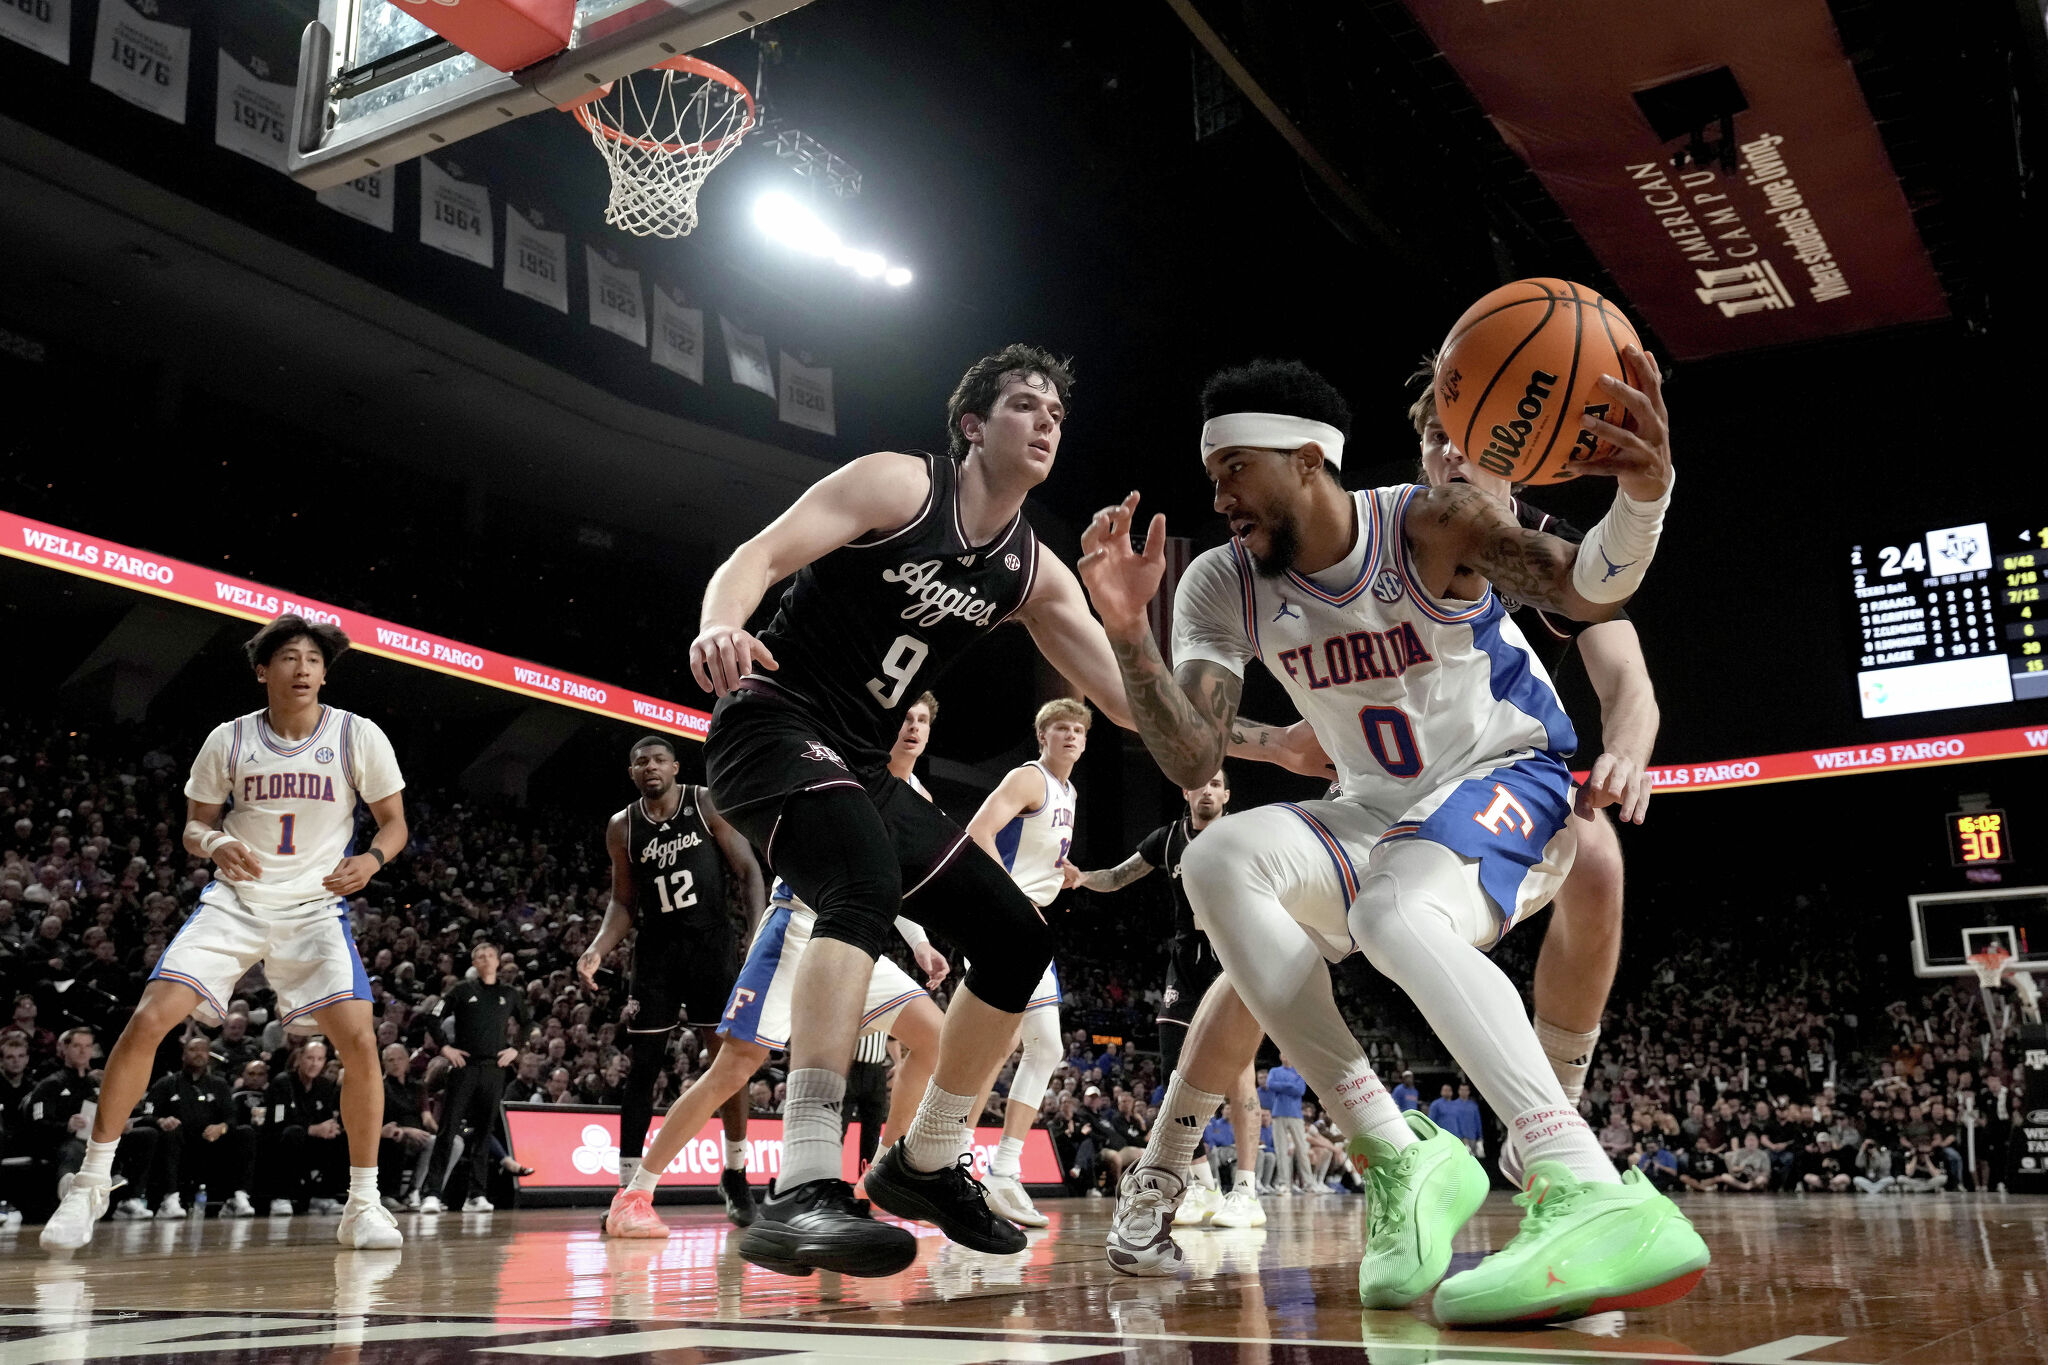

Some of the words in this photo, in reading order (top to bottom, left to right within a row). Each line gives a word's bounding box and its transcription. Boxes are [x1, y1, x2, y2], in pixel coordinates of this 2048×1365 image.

[111, 37, 170, 86] 1976
[233, 100, 285, 144] 1975
[1625, 162, 1720, 262] AMERICAN
[1670, 154, 1759, 258] CAMPU
[1762, 179, 1804, 215] love
[434, 201, 481, 236] 1964
[1775, 207, 1832, 263] students
[519, 250, 557, 283] 1951
[1808, 261, 1852, 302] Where
[599, 286, 637, 318] 1923
[1478, 369, 1559, 477] Wilson
[1552, 403, 1611, 478] CAA
[23, 527, 99, 564] WELLS
[103, 550, 174, 584] FARGO
[1005, 555, 1020, 570] SEC
[1851, 551, 1862, 565] 2
[1878, 542, 1927, 577] 24
[215, 581, 279, 614] WELLS
[882, 560, 997, 627] Aggies
[1373, 569, 1404, 602] SEC
[1854, 574, 1866, 588] 2
[2007, 588, 2040, 603] 7/12
[1929, 606, 1940, 617] 4
[2021, 606, 2032, 618] 4
[376, 627, 430, 657] WELLS
[433, 643, 484, 671] FARGO
[1862, 628, 1871, 639] 7
[1952, 630, 1961, 641] 1
[1986, 626, 1996, 637] 1
[1987, 640, 1997, 651] 1
[865, 634, 929, 709] 9
[1278, 621, 1434, 691] FLORIDA
[513, 667, 561, 692] WELLS
[562, 681, 607, 704] FARGO
[633, 699, 673, 723] WELLS
[316, 748, 334, 763] SEC
[1358, 705, 1424, 778] 0
[1813, 747, 1887, 770] WELLS
[1890, 739, 1965, 762] FARGO
[243, 772, 336, 802] FLORIDA
[1692, 761, 1760, 783] FARGO
[1472, 782, 1536, 840] F
[1958, 814, 2001, 833] 16:02
[276, 813, 296, 856] 1
[640, 831, 702, 869] Aggies
[1960, 831, 2002, 861] 30
[653, 869, 698, 913] 12
[725, 987, 756, 1020] F
